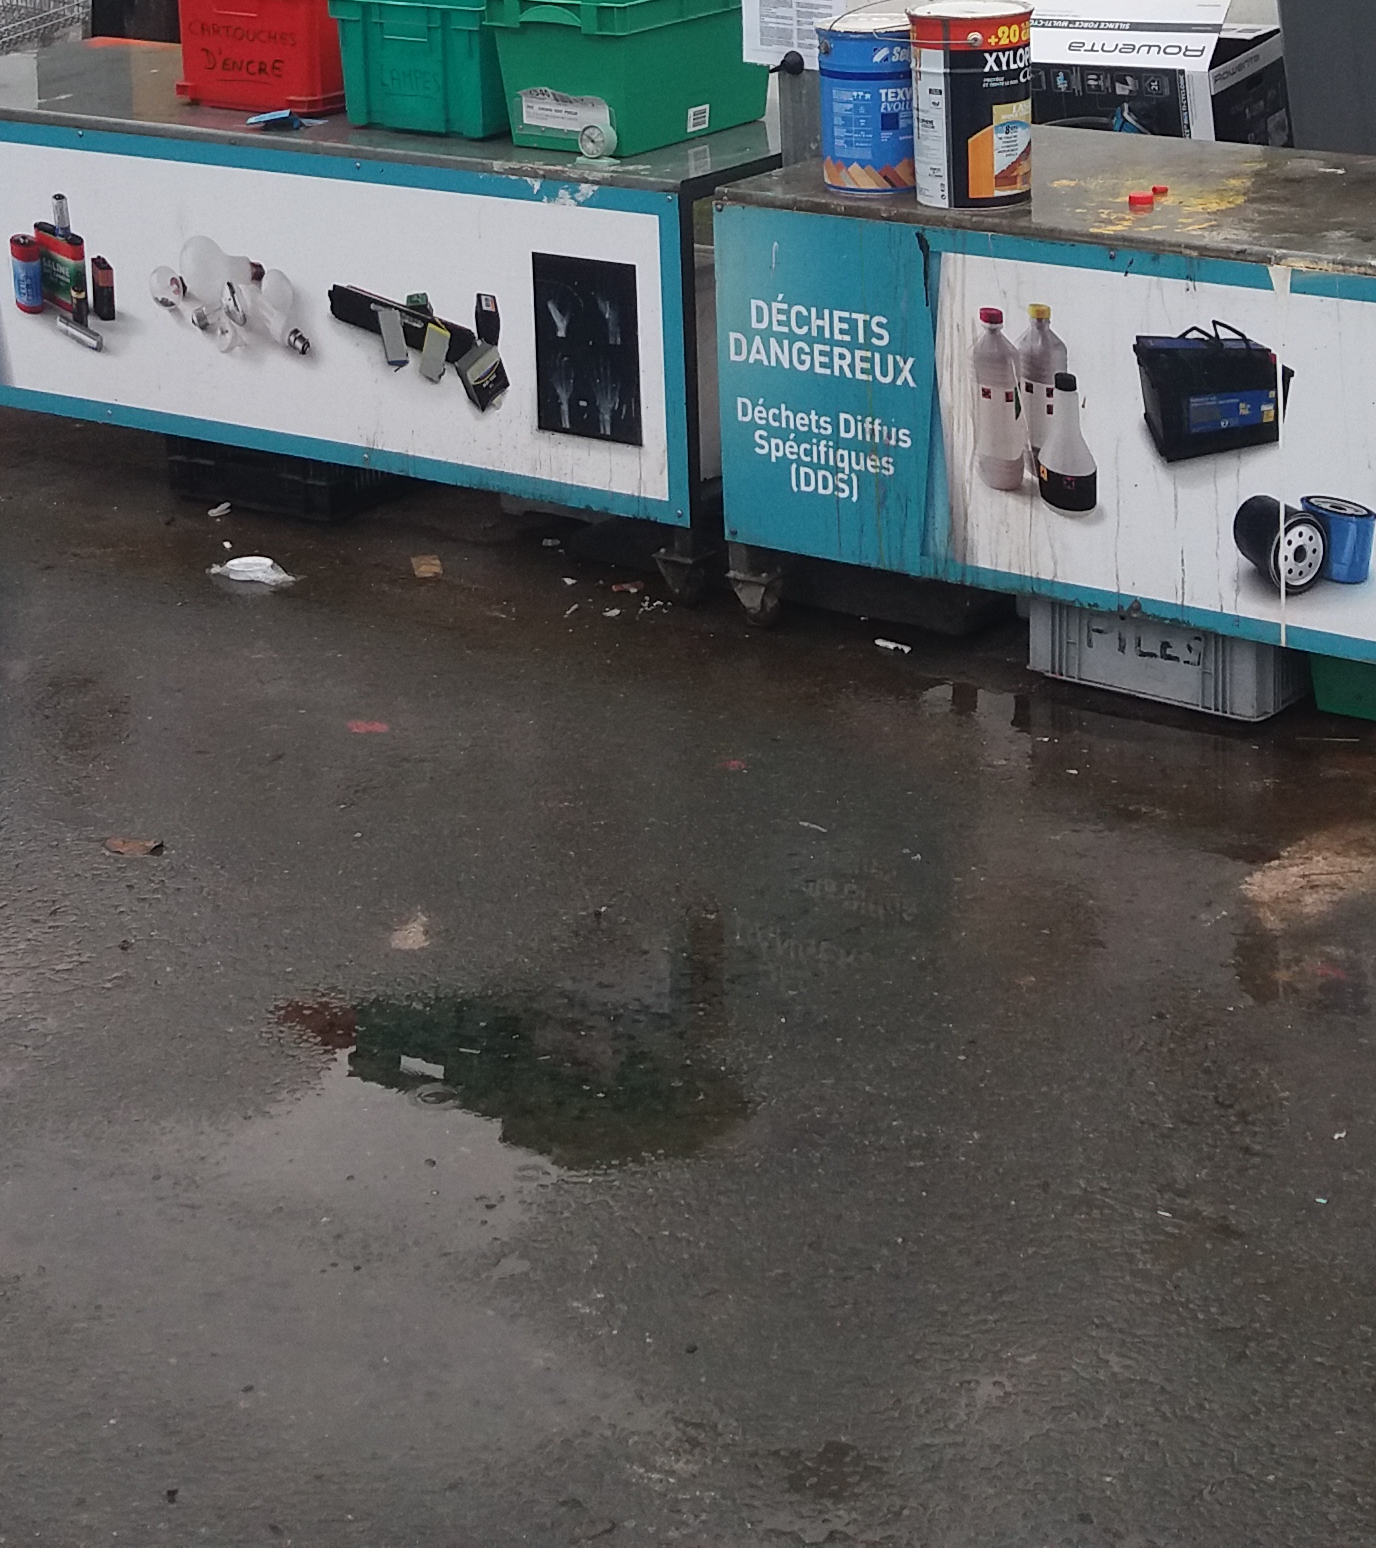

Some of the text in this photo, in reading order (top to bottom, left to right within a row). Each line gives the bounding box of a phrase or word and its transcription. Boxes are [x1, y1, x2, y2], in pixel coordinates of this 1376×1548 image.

[188, 20, 296, 46] CARTOUCHES
[201, 48, 285, 77] D'ENCRE
[380, 64, 441, 91] LAMPES
[983, 46, 1032, 73] XYLOP
[751, 293, 890, 346] DÉCHETS
[729, 332, 917, 388] DANGEREUX
[737, 397, 911, 448] Déchets Diffus
[754, 430, 894, 476] Spécifiques
[791, 462, 858, 502] (DDS)
